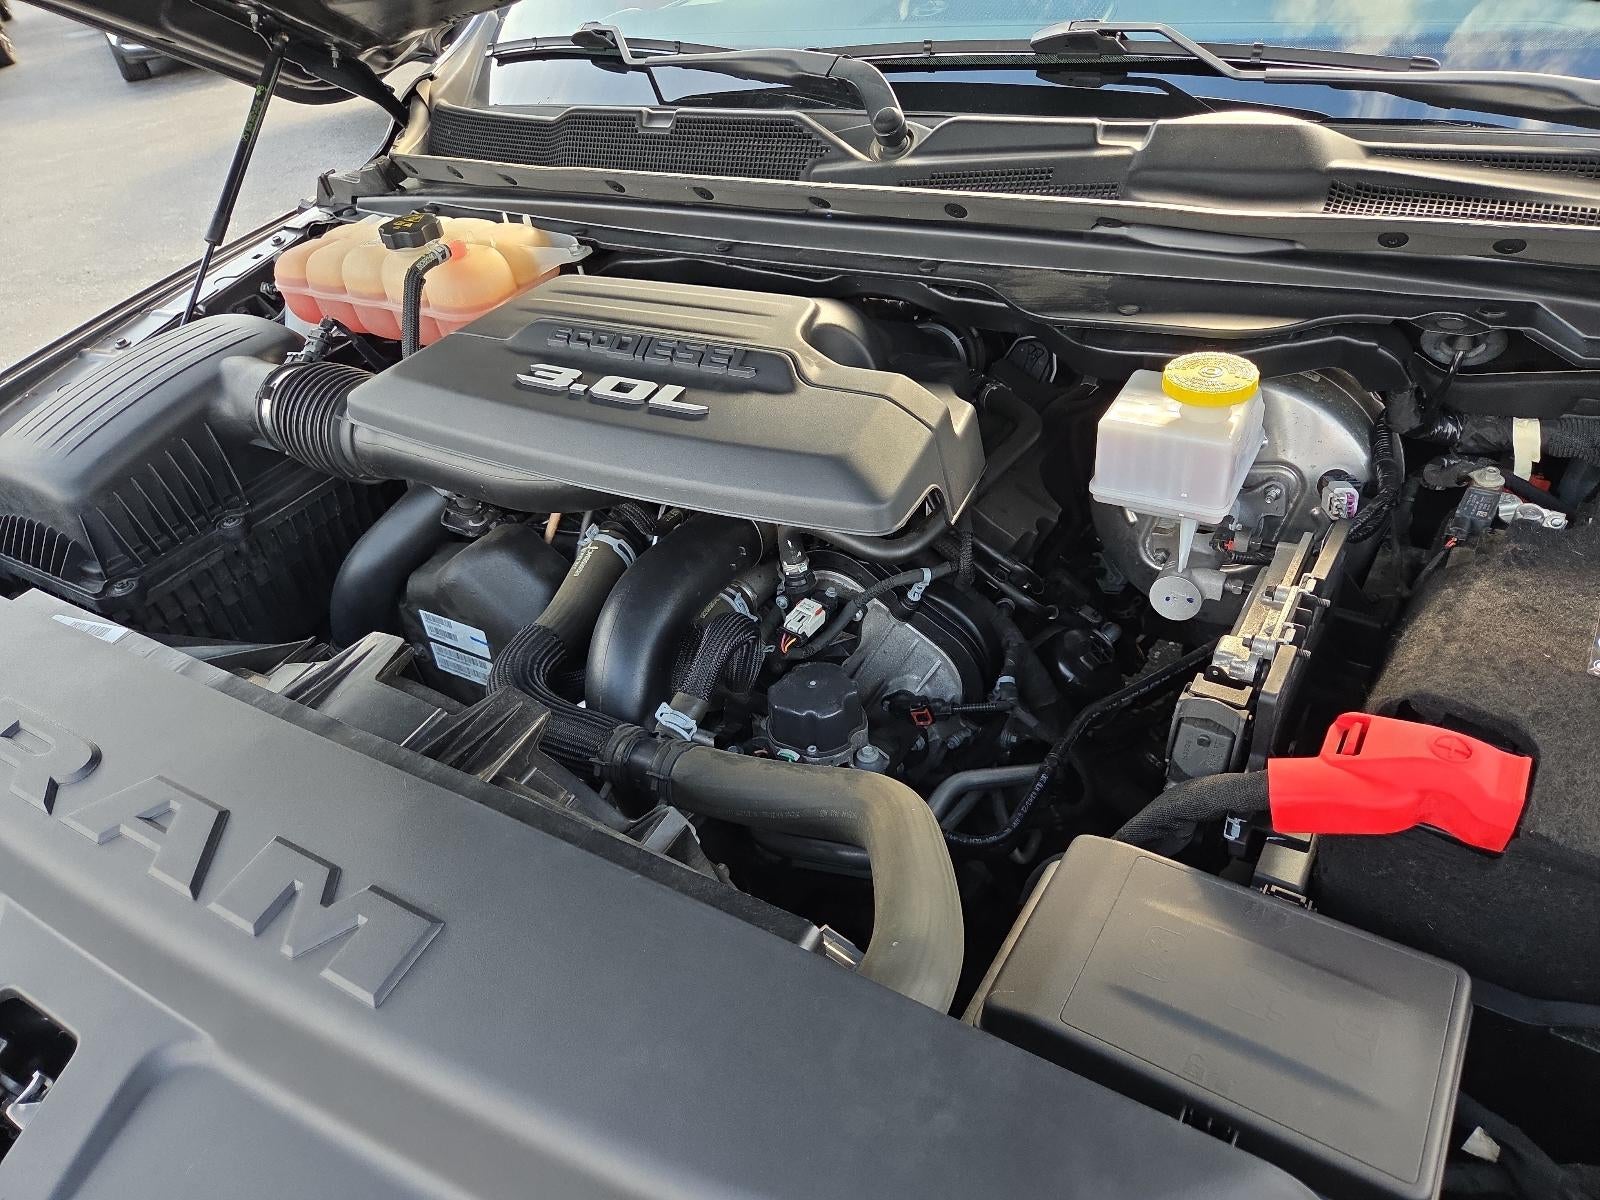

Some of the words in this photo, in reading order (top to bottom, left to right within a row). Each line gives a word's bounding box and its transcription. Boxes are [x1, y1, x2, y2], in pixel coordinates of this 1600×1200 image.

[547, 327, 757, 379] ECODIESEL
[516, 363, 710, 416] 3.0L
[0, 697, 446, 1008] RAM
